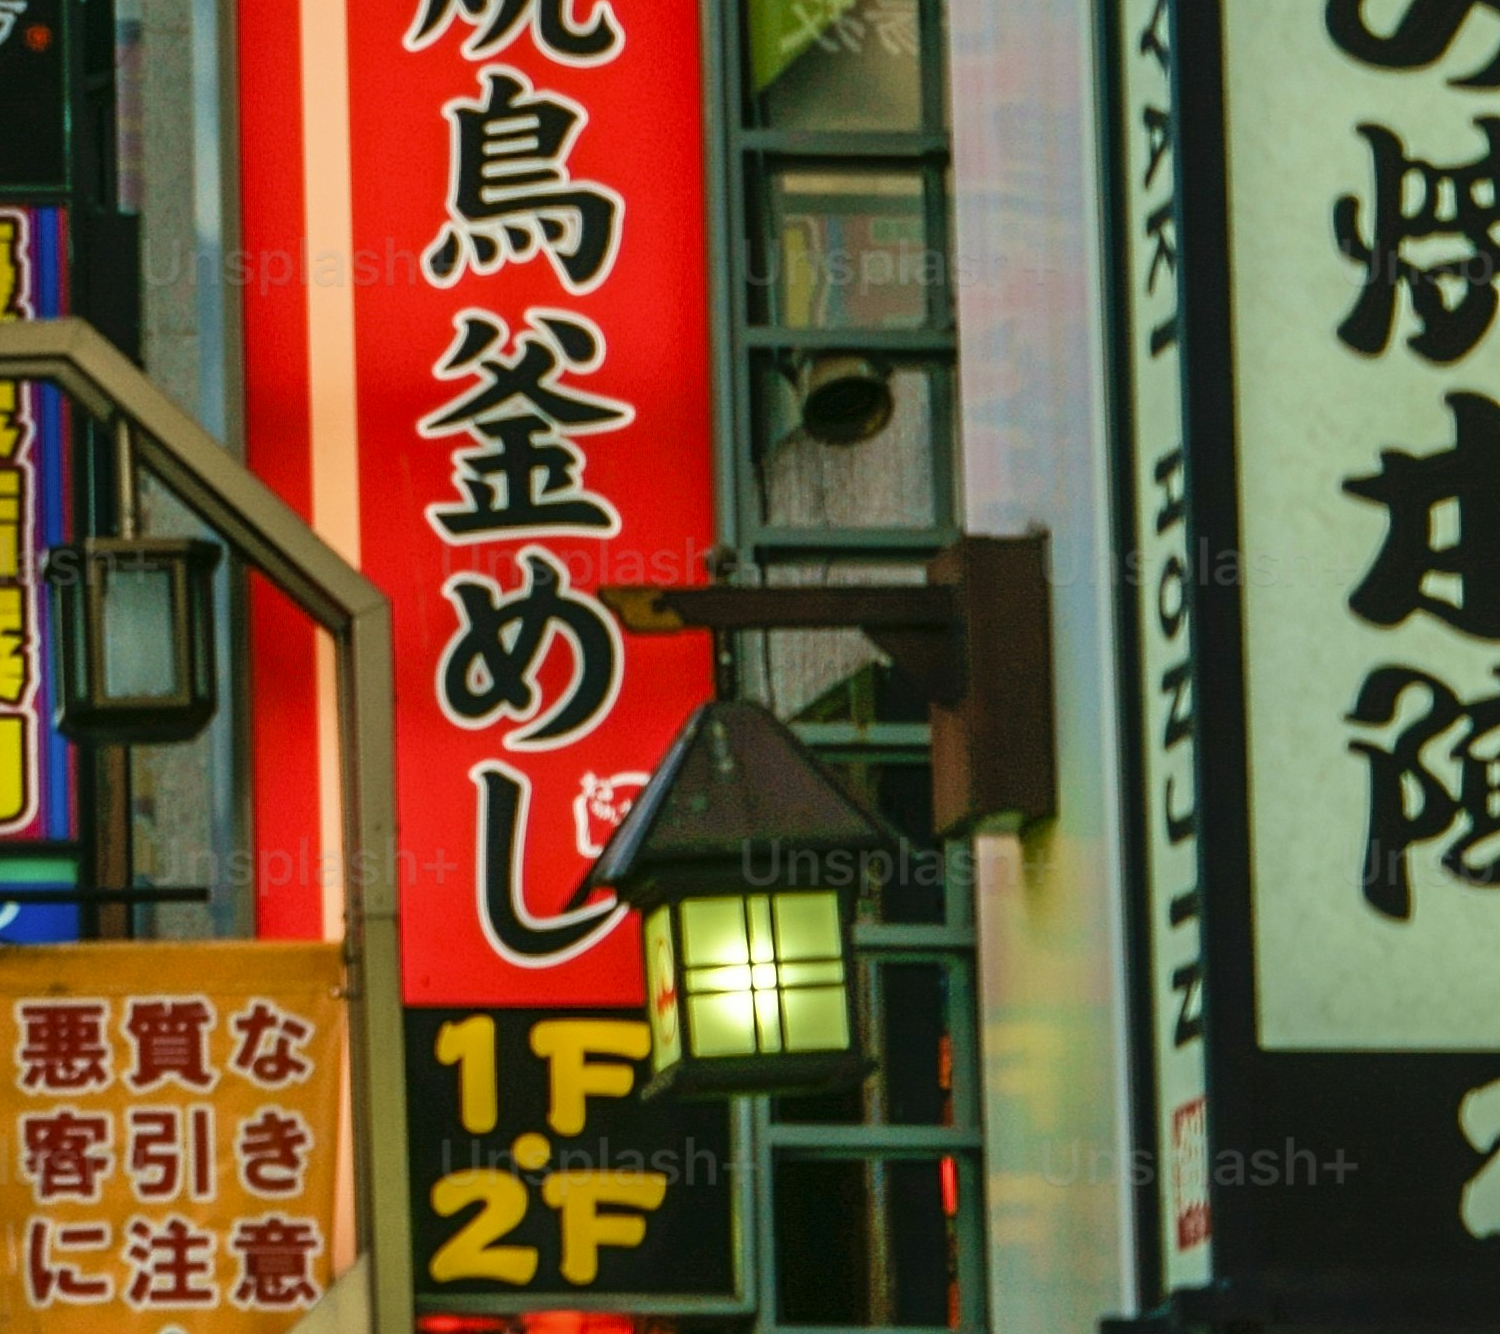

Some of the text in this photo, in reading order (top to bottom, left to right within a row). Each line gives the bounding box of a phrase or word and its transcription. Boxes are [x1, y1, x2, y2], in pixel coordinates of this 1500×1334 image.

[17, 997, 313, 1095] 悪質な
[21, 1107, 313, 1205] 客引き
[25, 1216, 324, 1314] に注意
[430, 1167, 670, 1287] 2F
